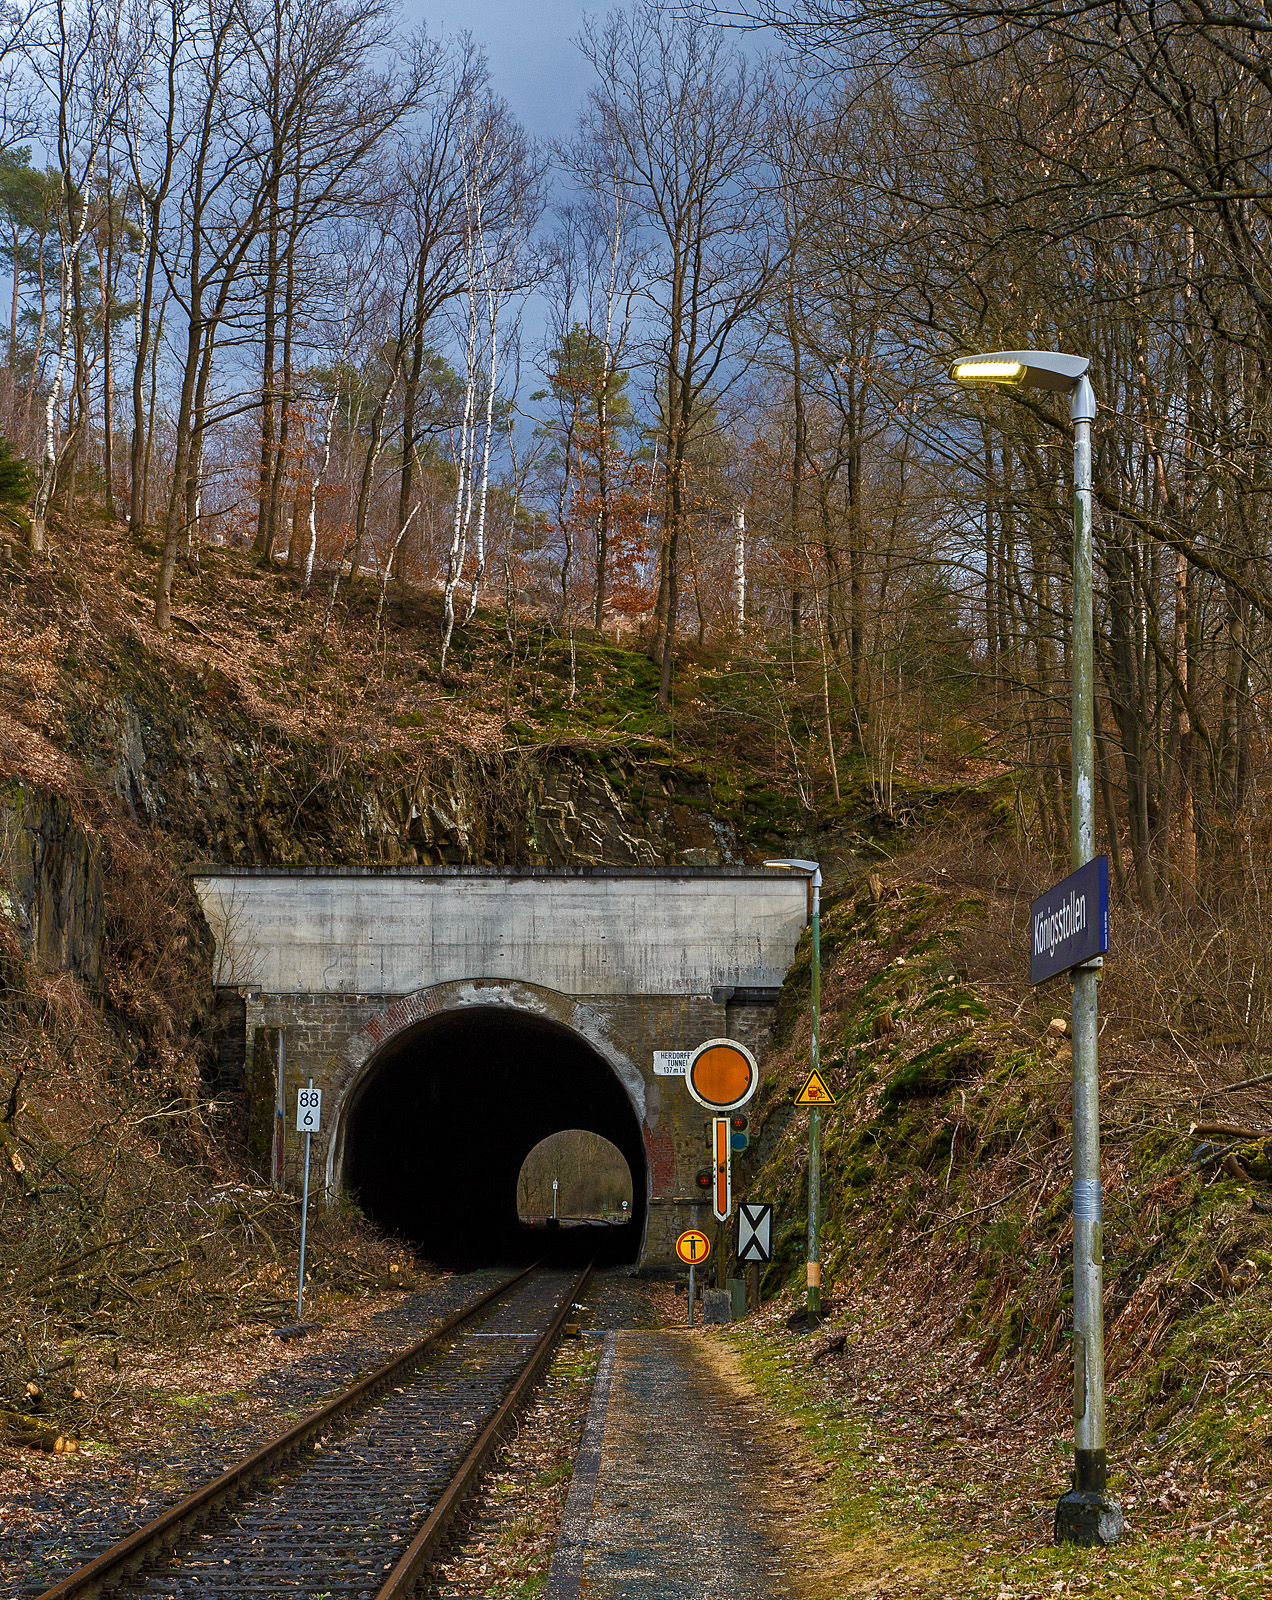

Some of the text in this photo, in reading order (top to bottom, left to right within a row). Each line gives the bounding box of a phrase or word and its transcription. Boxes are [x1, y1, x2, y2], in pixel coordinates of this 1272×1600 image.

[1034, 890, 1086, 958] Königsstollen
[300, 1092, 319, 1108] 88
[303, 1110, 314, 1126] 6
